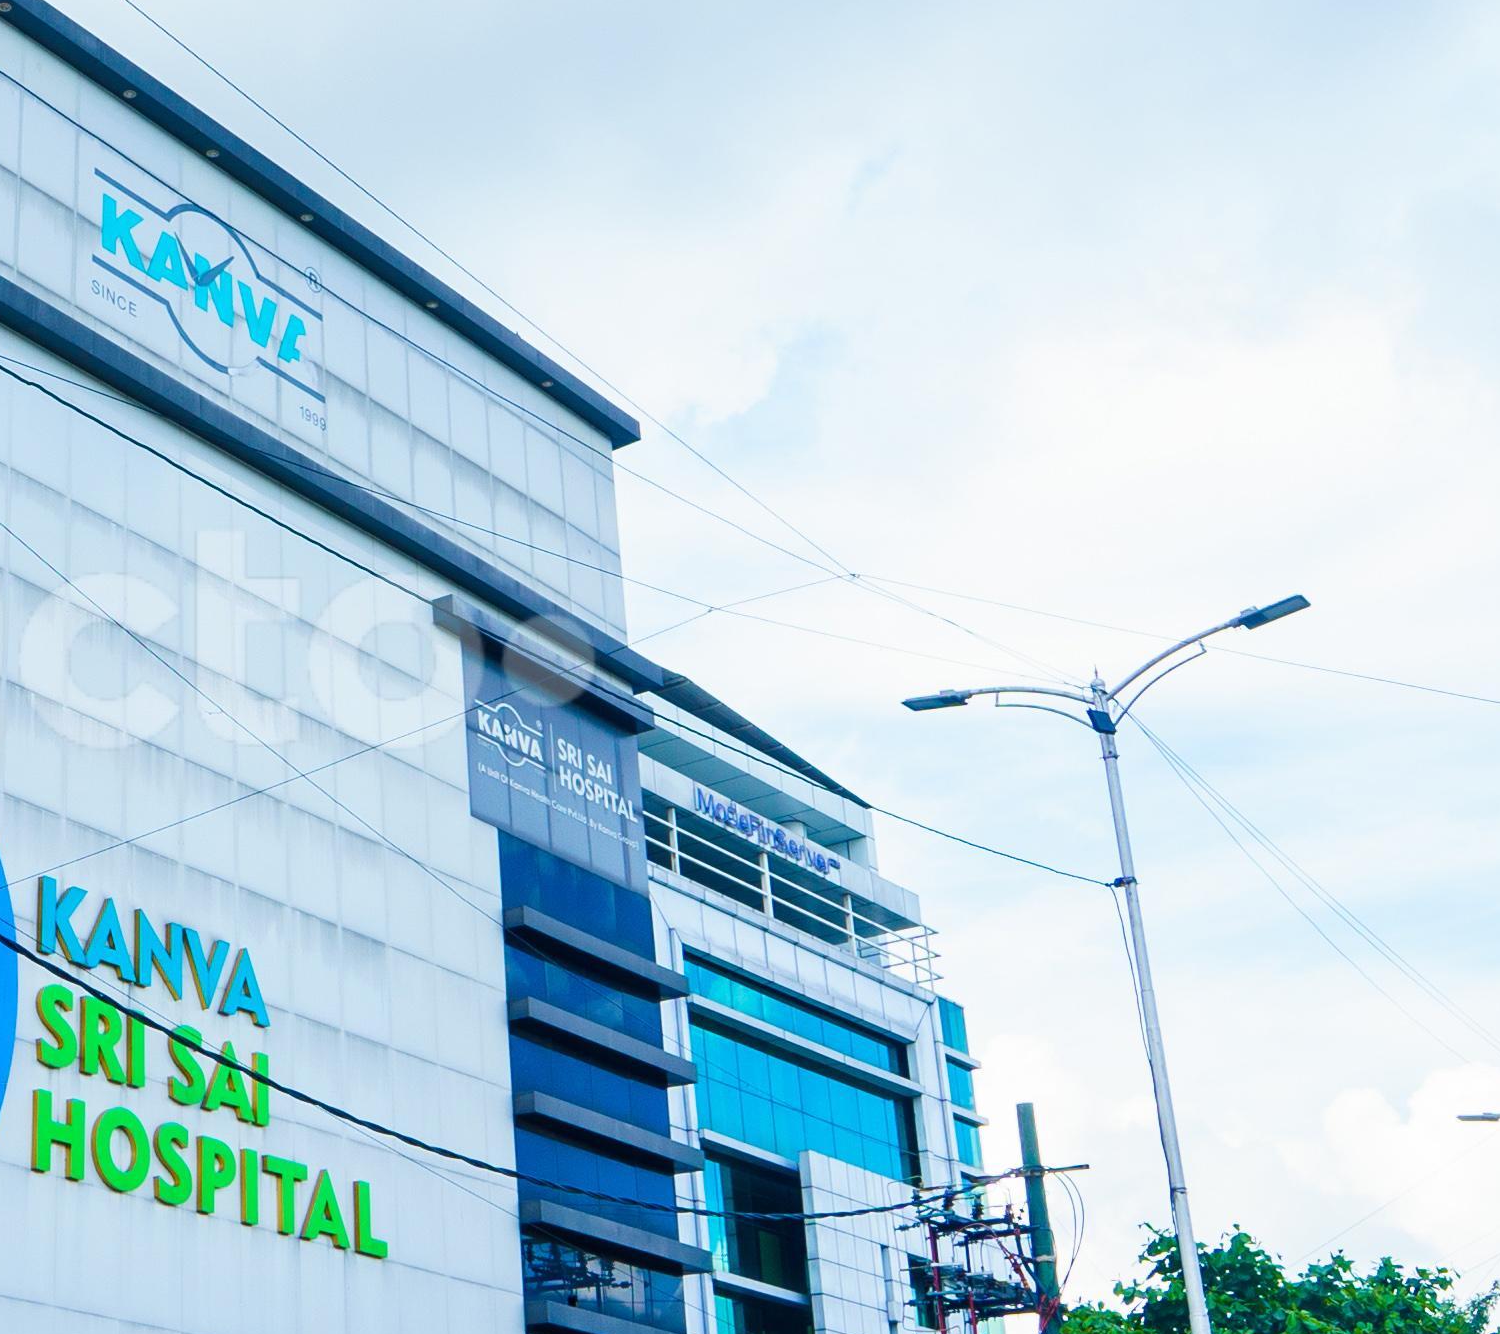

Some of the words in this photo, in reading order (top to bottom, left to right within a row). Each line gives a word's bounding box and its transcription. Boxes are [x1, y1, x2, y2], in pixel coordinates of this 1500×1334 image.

[91, 279, 137, 318] SINCE
[300, 405, 328, 431] 1999
[477, 710, 543, 762] KANVA
[557, 738, 582, 768] SRI
[587, 753, 612, 785] SAI
[559, 766, 639, 823] HOSPITAL
[36, 876, 270, 1028] KANVA
[36, 983, 145, 1089] SRI
[168, 1024, 270, 1128] SAI
[30, 1089, 388, 1259] HOSPITAL
